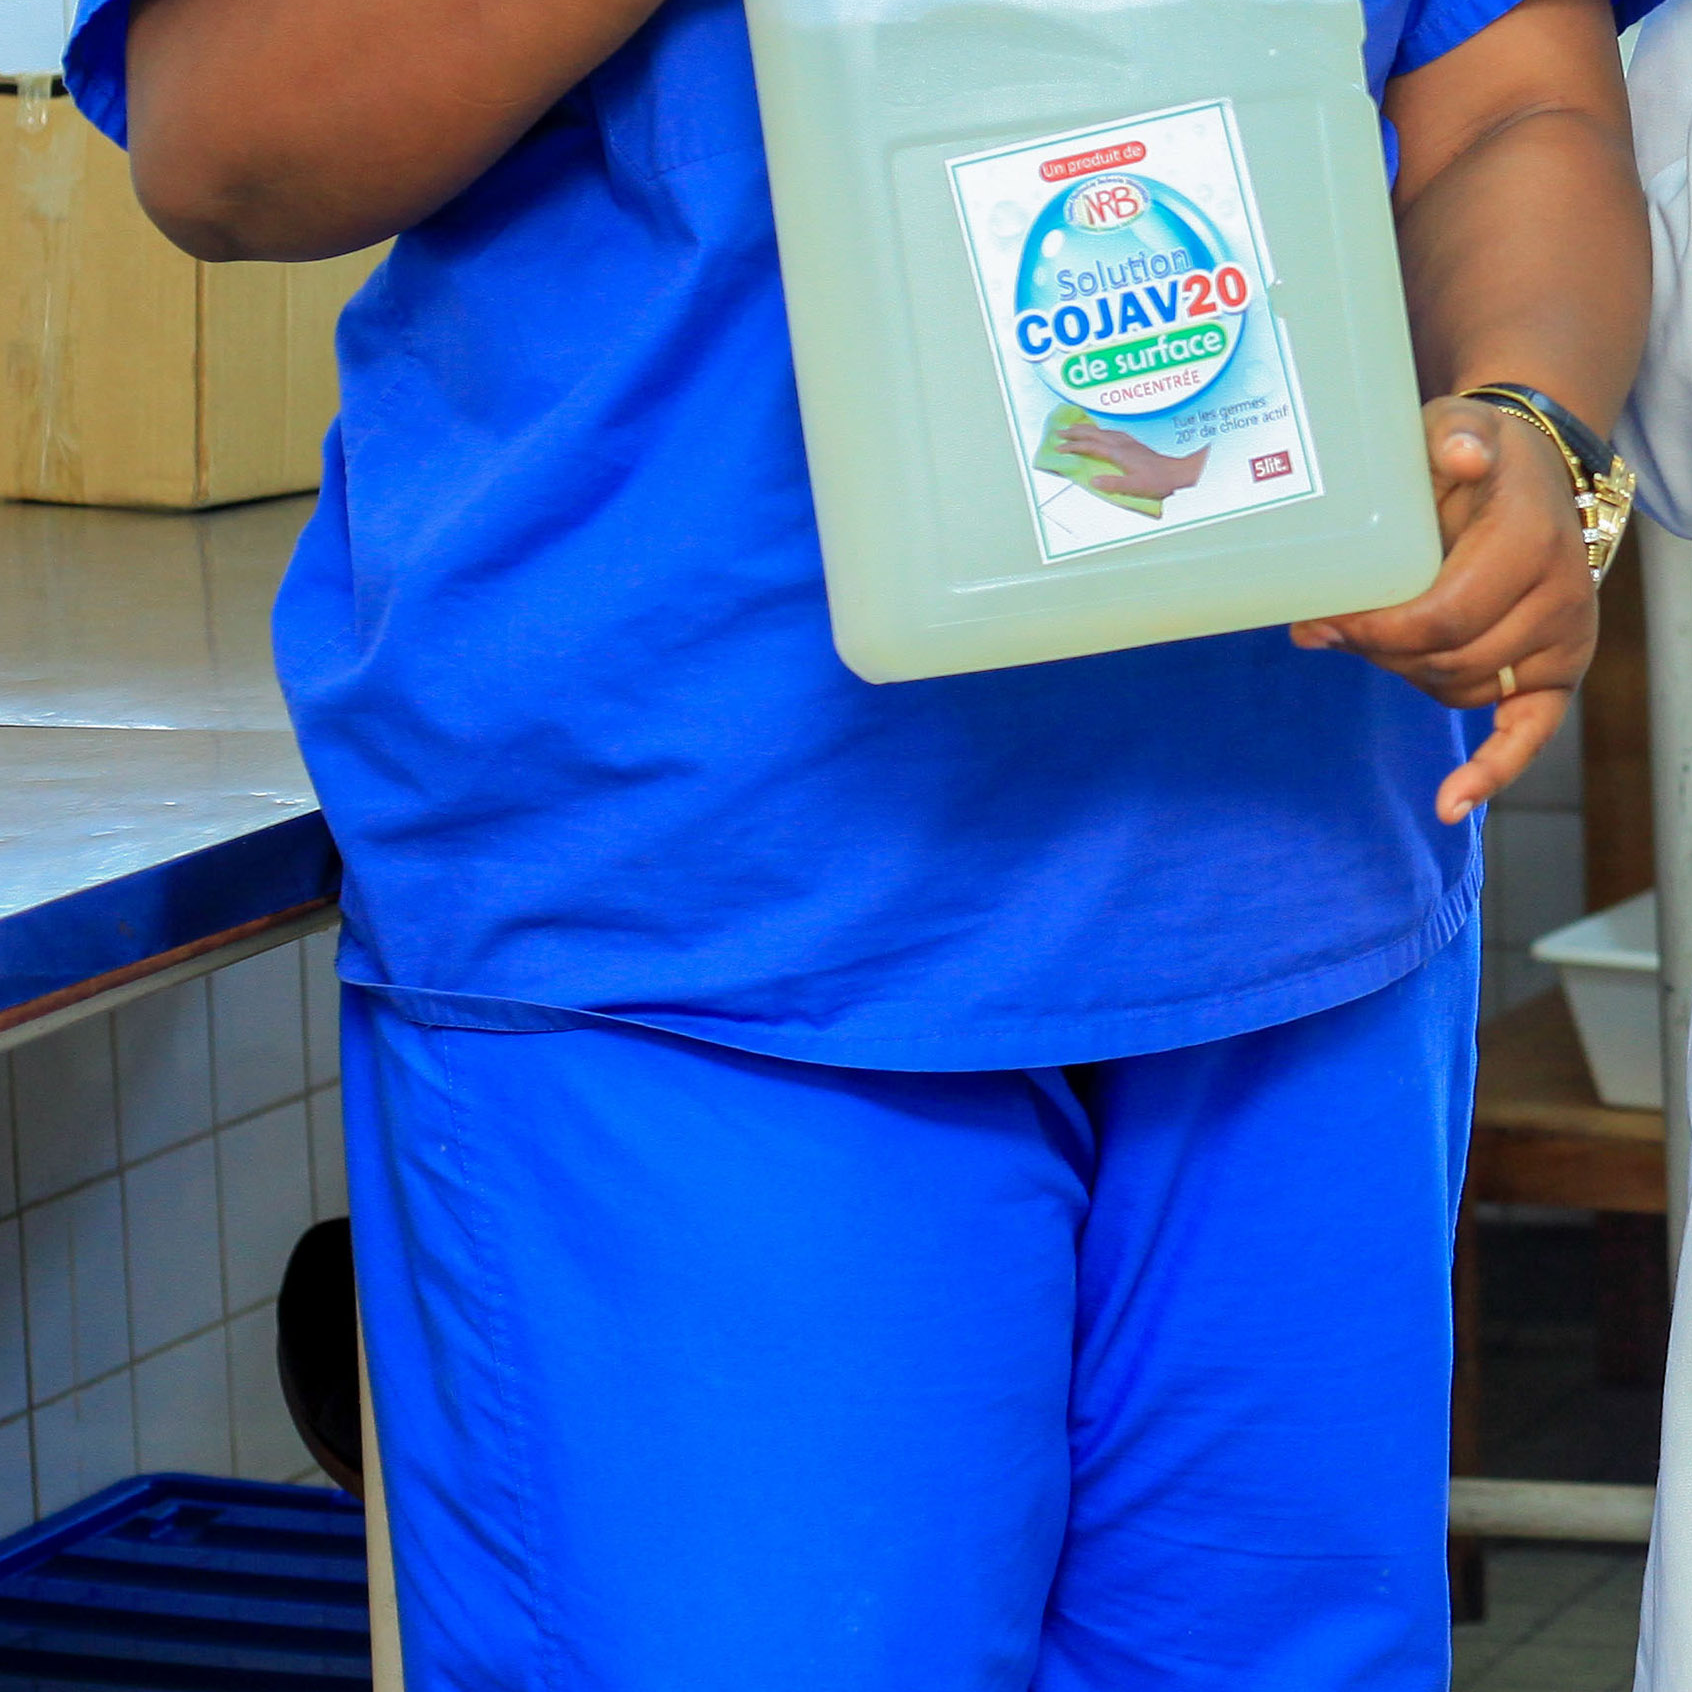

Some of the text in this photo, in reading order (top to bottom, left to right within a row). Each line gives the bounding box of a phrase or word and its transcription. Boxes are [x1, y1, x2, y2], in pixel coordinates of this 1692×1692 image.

[1042, 145, 1142, 178] Un produit de
[1056, 248, 1193, 301] Solution
[1067, 331, 1222, 385] de surface
[1100, 369, 1200, 406] CONCENTRÉE
[1198, 409, 1216, 422] les
[1219, 396, 1267, 419] germes
[1200, 423, 1216, 438] de
[1220, 415, 1258, 434] chlore
[1262, 404, 1289, 423] actif
